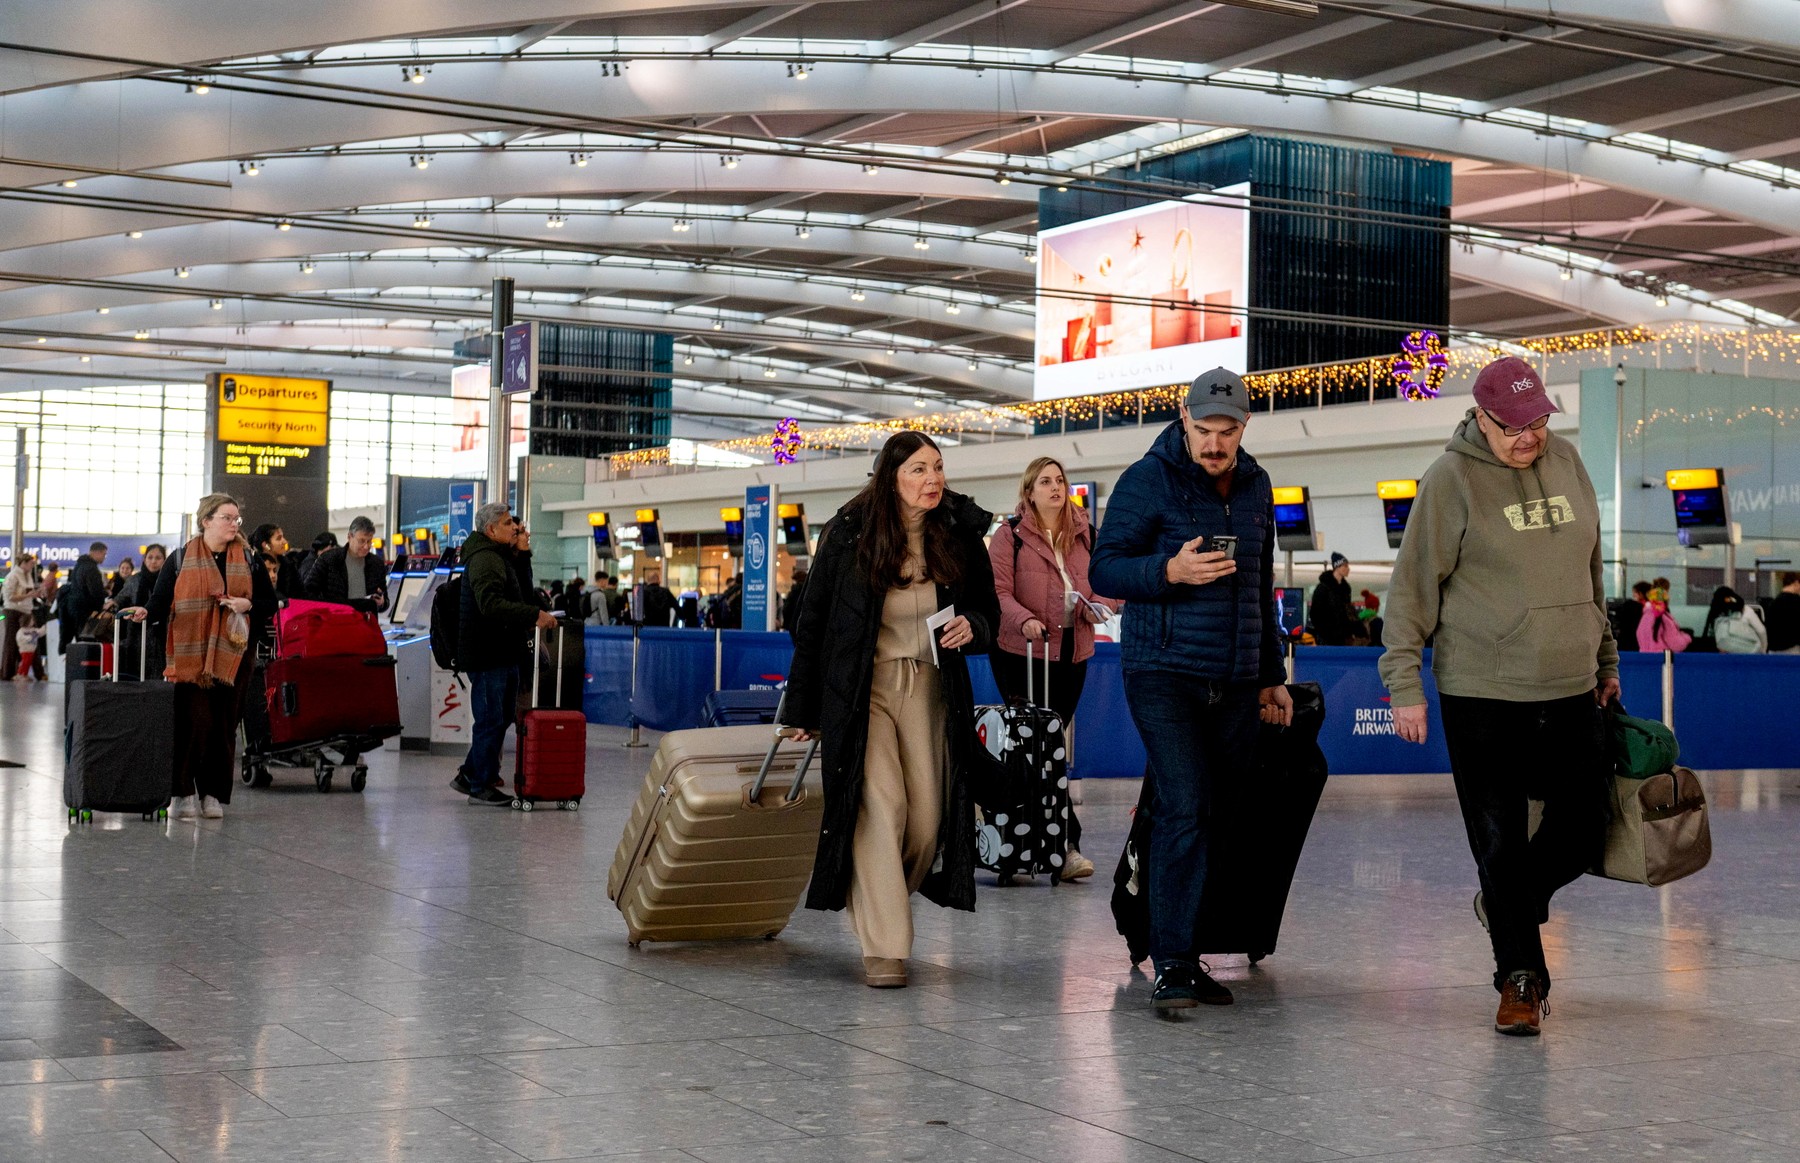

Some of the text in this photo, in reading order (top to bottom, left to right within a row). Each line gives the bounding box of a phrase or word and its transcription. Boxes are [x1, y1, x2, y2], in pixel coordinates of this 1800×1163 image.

[239, 385, 318, 400] Departures
[238, 420, 317, 432] Security North
[227, 444, 247, 453] How
[247, 445, 266, 456] busy
[226, 455, 251, 465] North
[226, 464, 251, 474] South
[41, 543, 79, 561] home
[1355, 708, 1394, 721] BRITIS
[1352, 722, 1396, 735] AIRWAY
